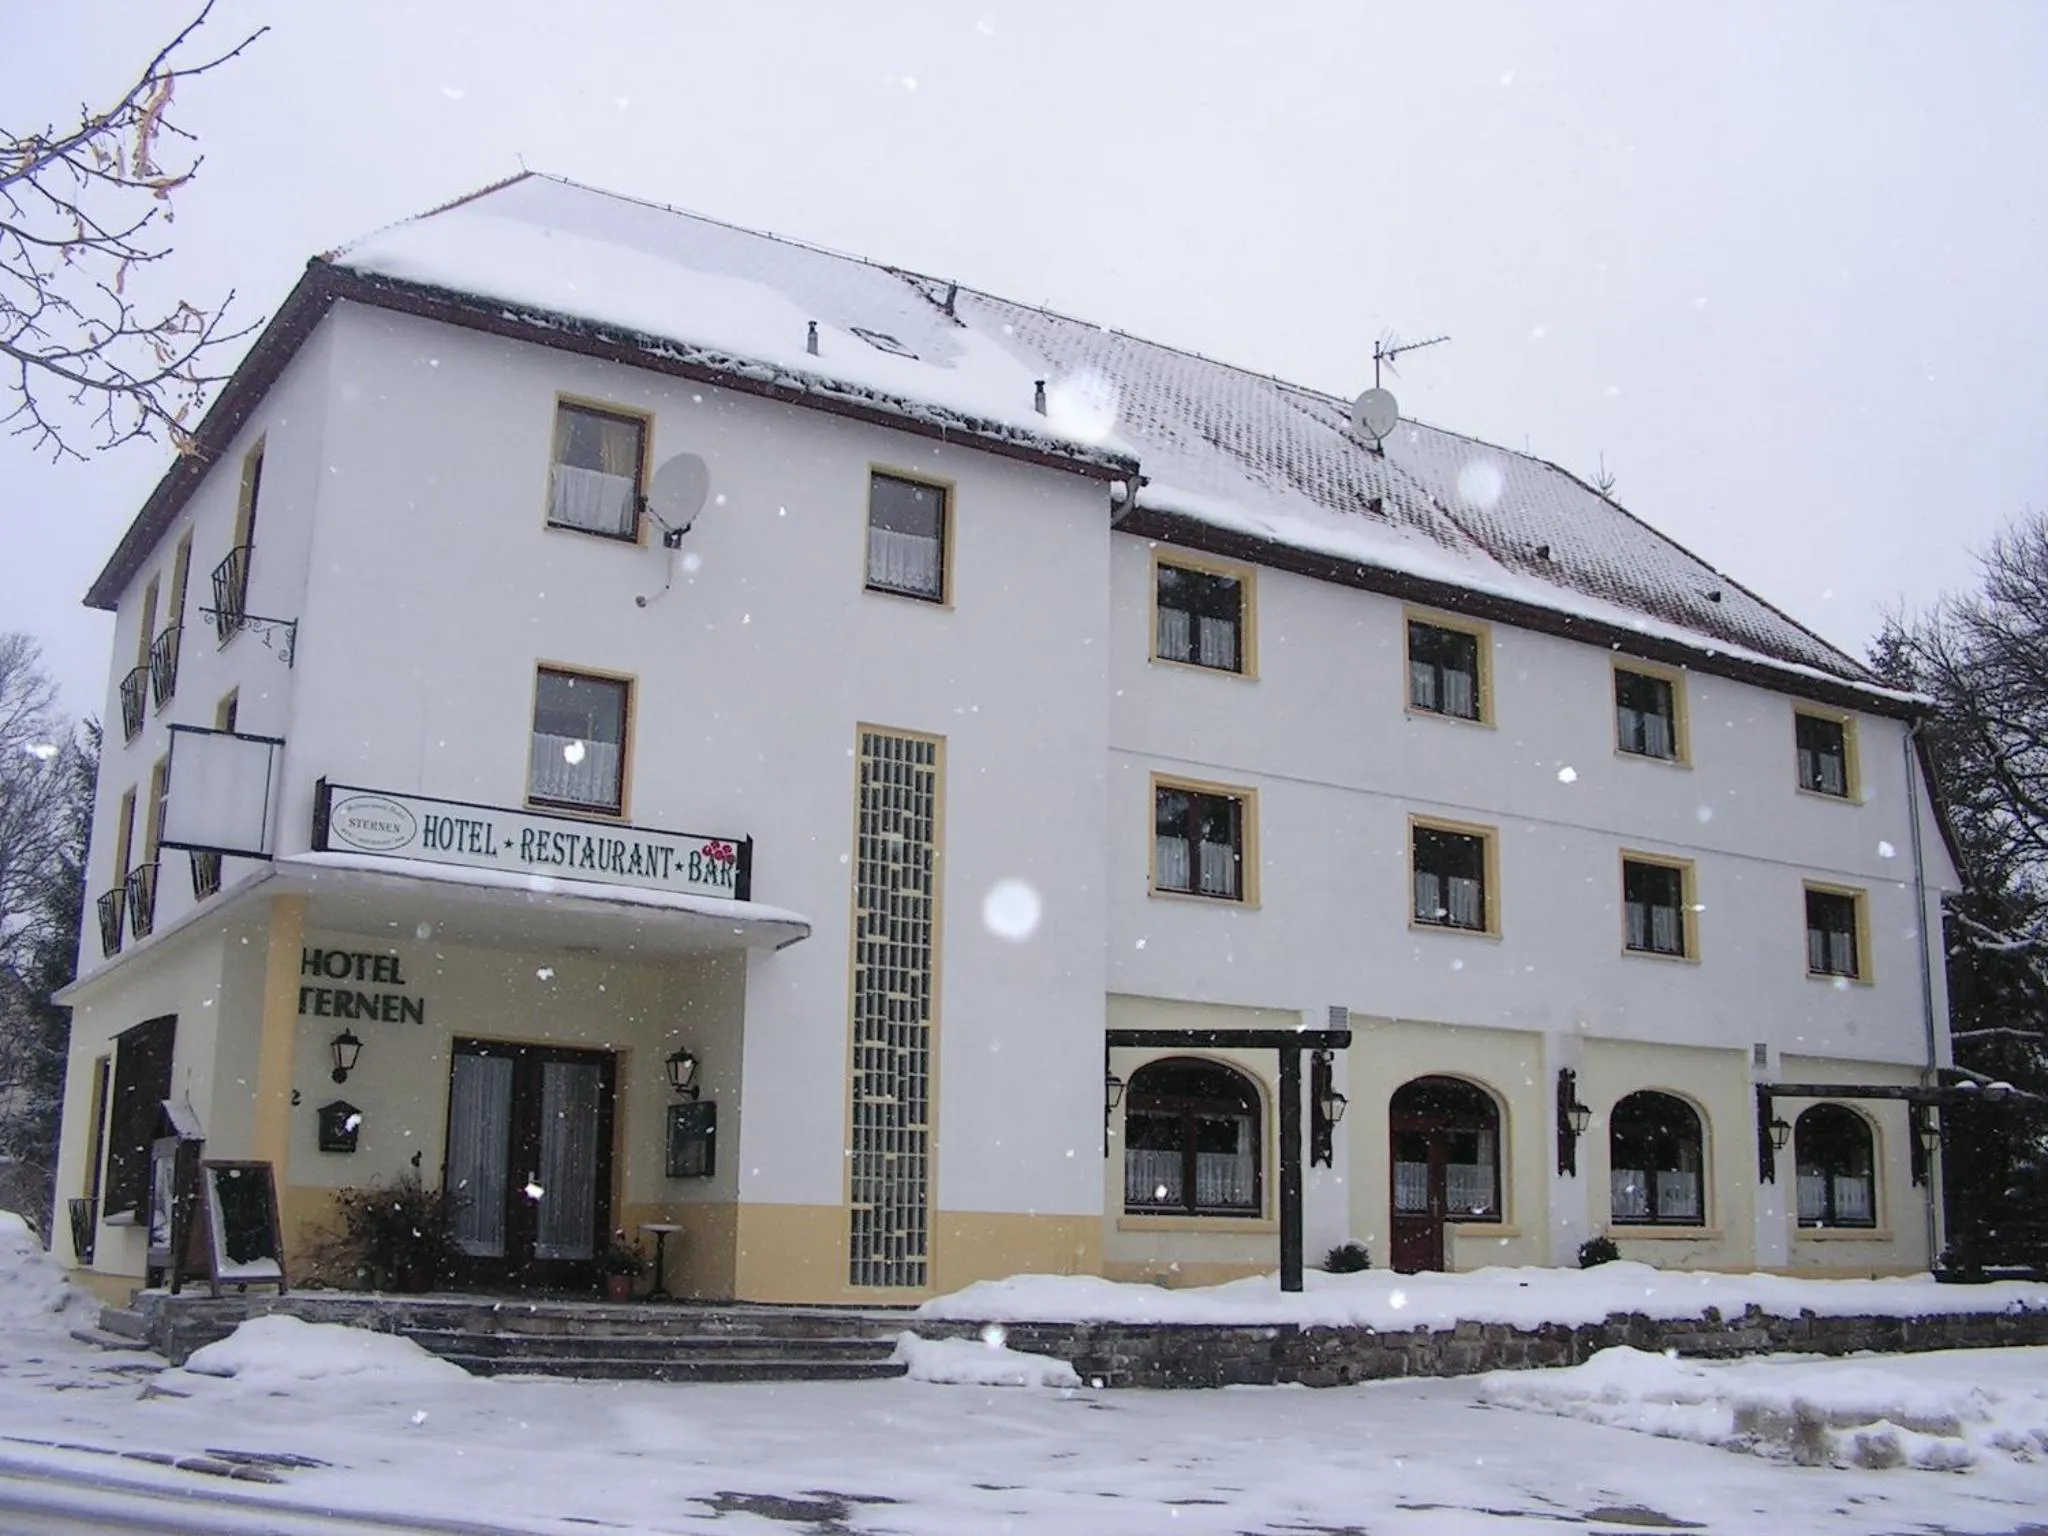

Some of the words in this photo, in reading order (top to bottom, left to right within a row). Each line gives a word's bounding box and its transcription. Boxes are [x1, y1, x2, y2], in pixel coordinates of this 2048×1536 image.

[348, 817, 401, 833] STERNEN
[422, 813, 499, 857] HOTEL
[519, 827, 675, 879] RESTAURANT
[301, 947, 406, 985] HOTEL
[298, 986, 425, 1025] TERNEN
[290, 1088, 302, 1107] 2
